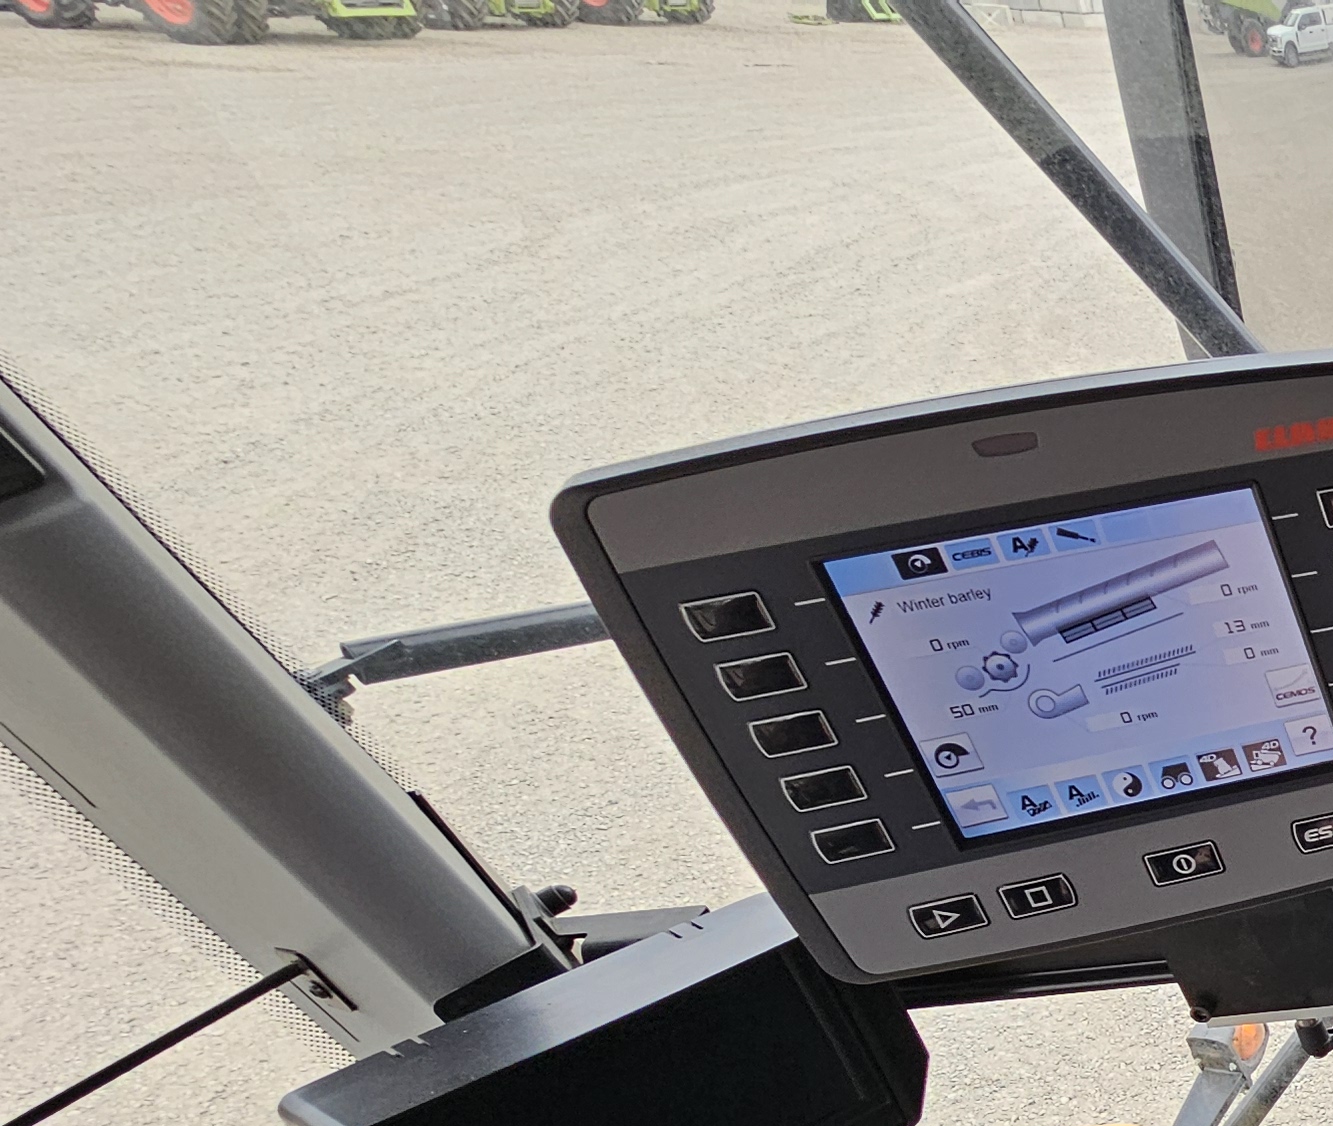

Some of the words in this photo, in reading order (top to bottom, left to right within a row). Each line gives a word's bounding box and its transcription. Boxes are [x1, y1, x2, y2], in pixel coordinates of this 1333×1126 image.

[951, 546, 993, 563] CEBIS
[1220, 583, 1233, 597] 0
[1236, 583, 1259, 596] rpm
[897, 595, 946, 615] Winter
[949, 587, 992, 606] barley
[1224, 619, 1247, 635] 13
[1250, 619, 1270, 631] mm
[929, 637, 944, 652] 0
[946, 638, 970, 651] rpm
[1243, 646, 1256, 660] 0
[1260, 646, 1280, 658] mm
[1275, 685, 1317, 702] CEMOS
[950, 703, 975, 719] 50
[978, 702, 999, 715] mm
[1120, 711, 1133, 724] 0
[1136, 710, 1159, 723] rpm
[1301, 725, 1318, 746] ?
[1261, 739, 1280, 751] 4D
[1199, 752, 1217, 763] 4D
